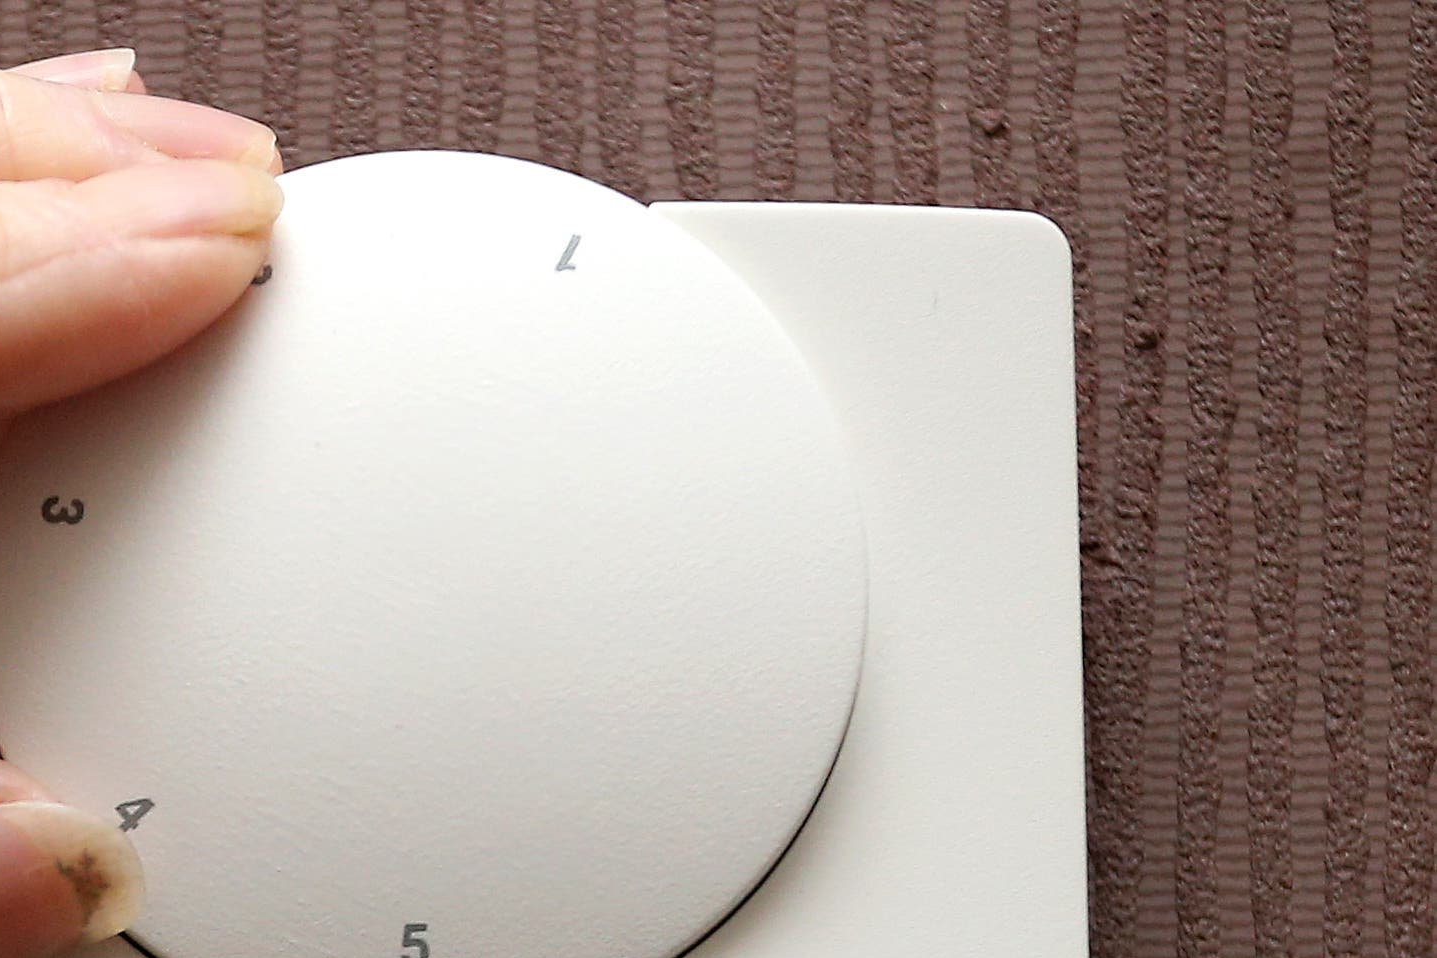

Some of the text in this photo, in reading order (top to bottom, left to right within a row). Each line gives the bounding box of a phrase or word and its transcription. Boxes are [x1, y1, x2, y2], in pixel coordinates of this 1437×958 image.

[556, 234, 581, 271] 1
[42, 496, 84, 525] 3
[115, 798, 154, 832] 4
